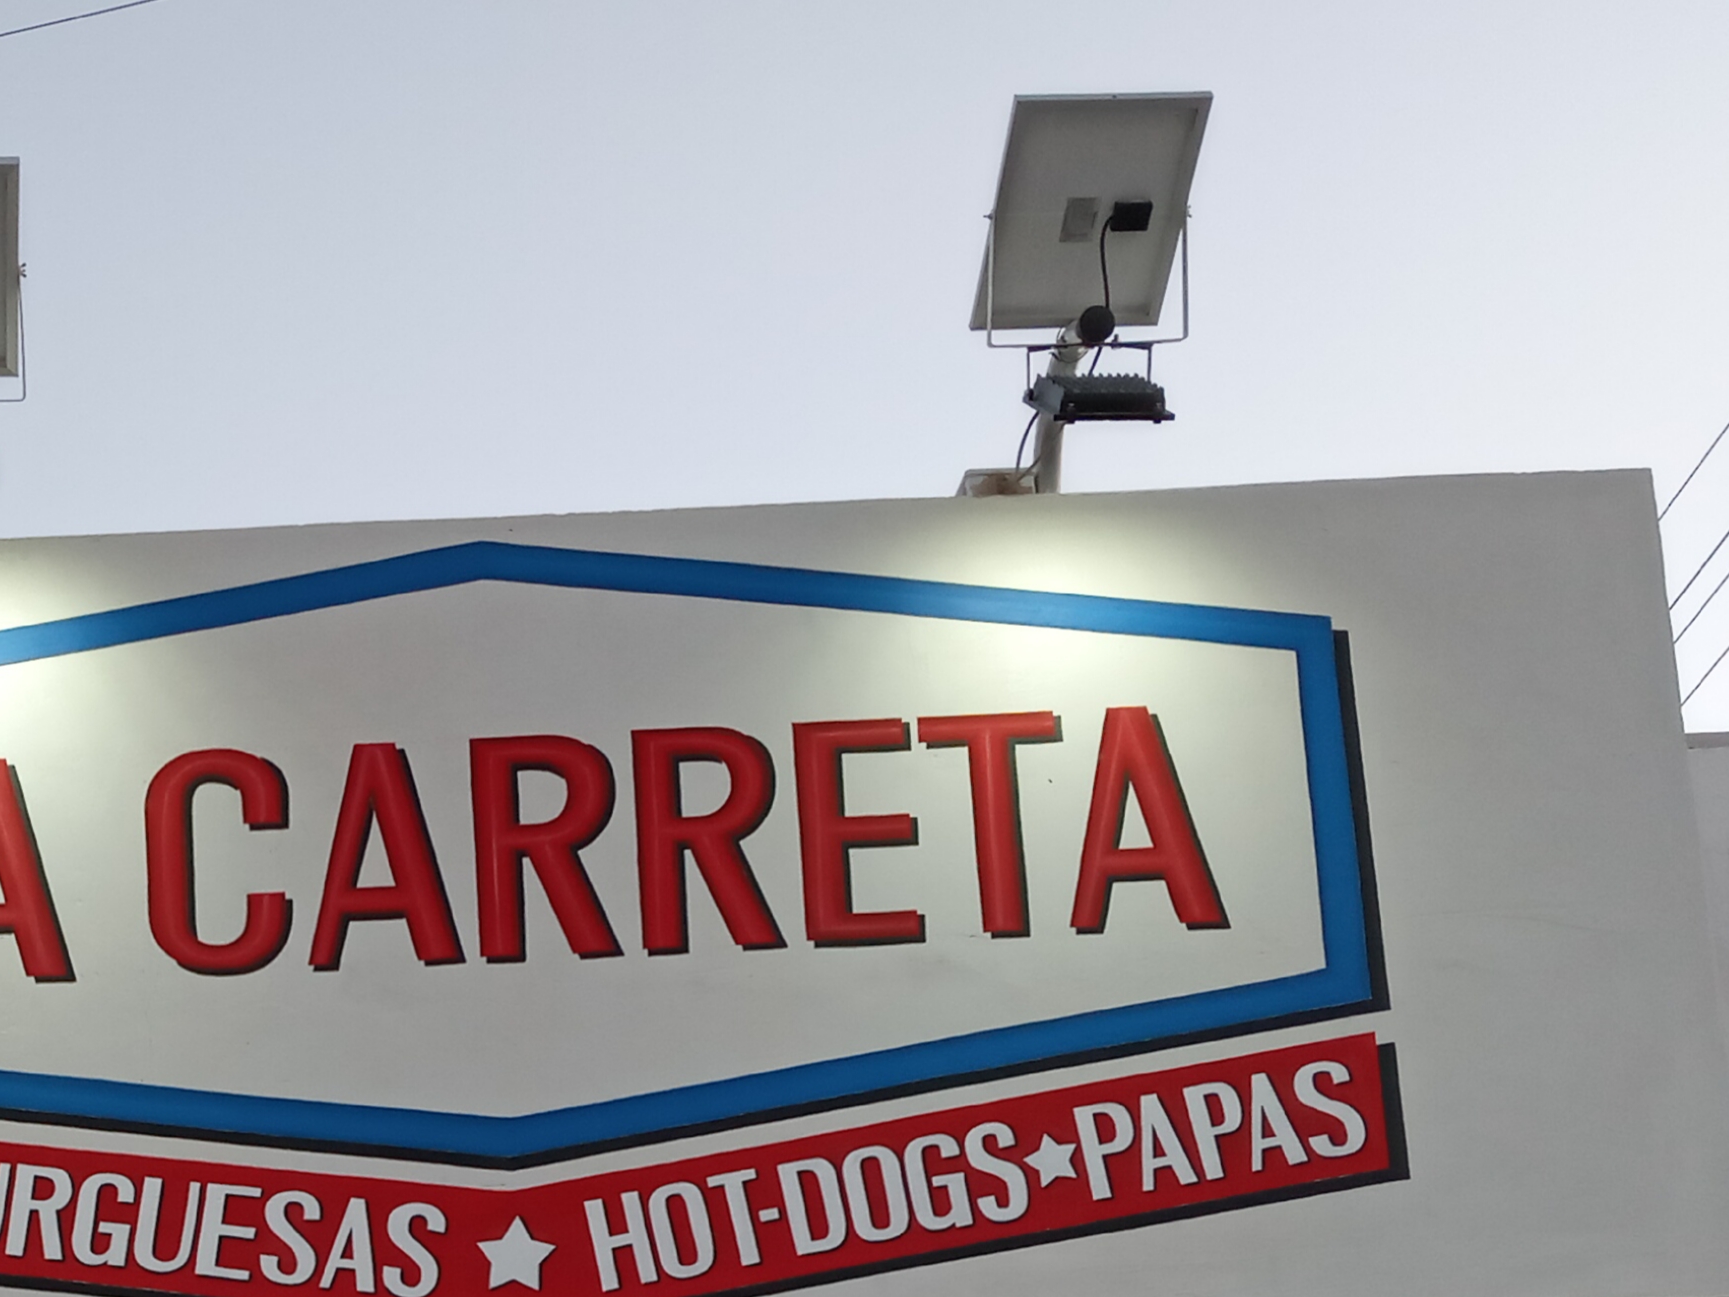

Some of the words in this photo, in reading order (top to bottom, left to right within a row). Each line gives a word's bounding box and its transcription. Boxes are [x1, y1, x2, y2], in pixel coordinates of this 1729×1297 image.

[144, 706, 1231, 975] CARRETA
[584, 1121, 1030, 1292] HOT-DOGS
[1073, 1059, 1368, 1202] PAPAS
